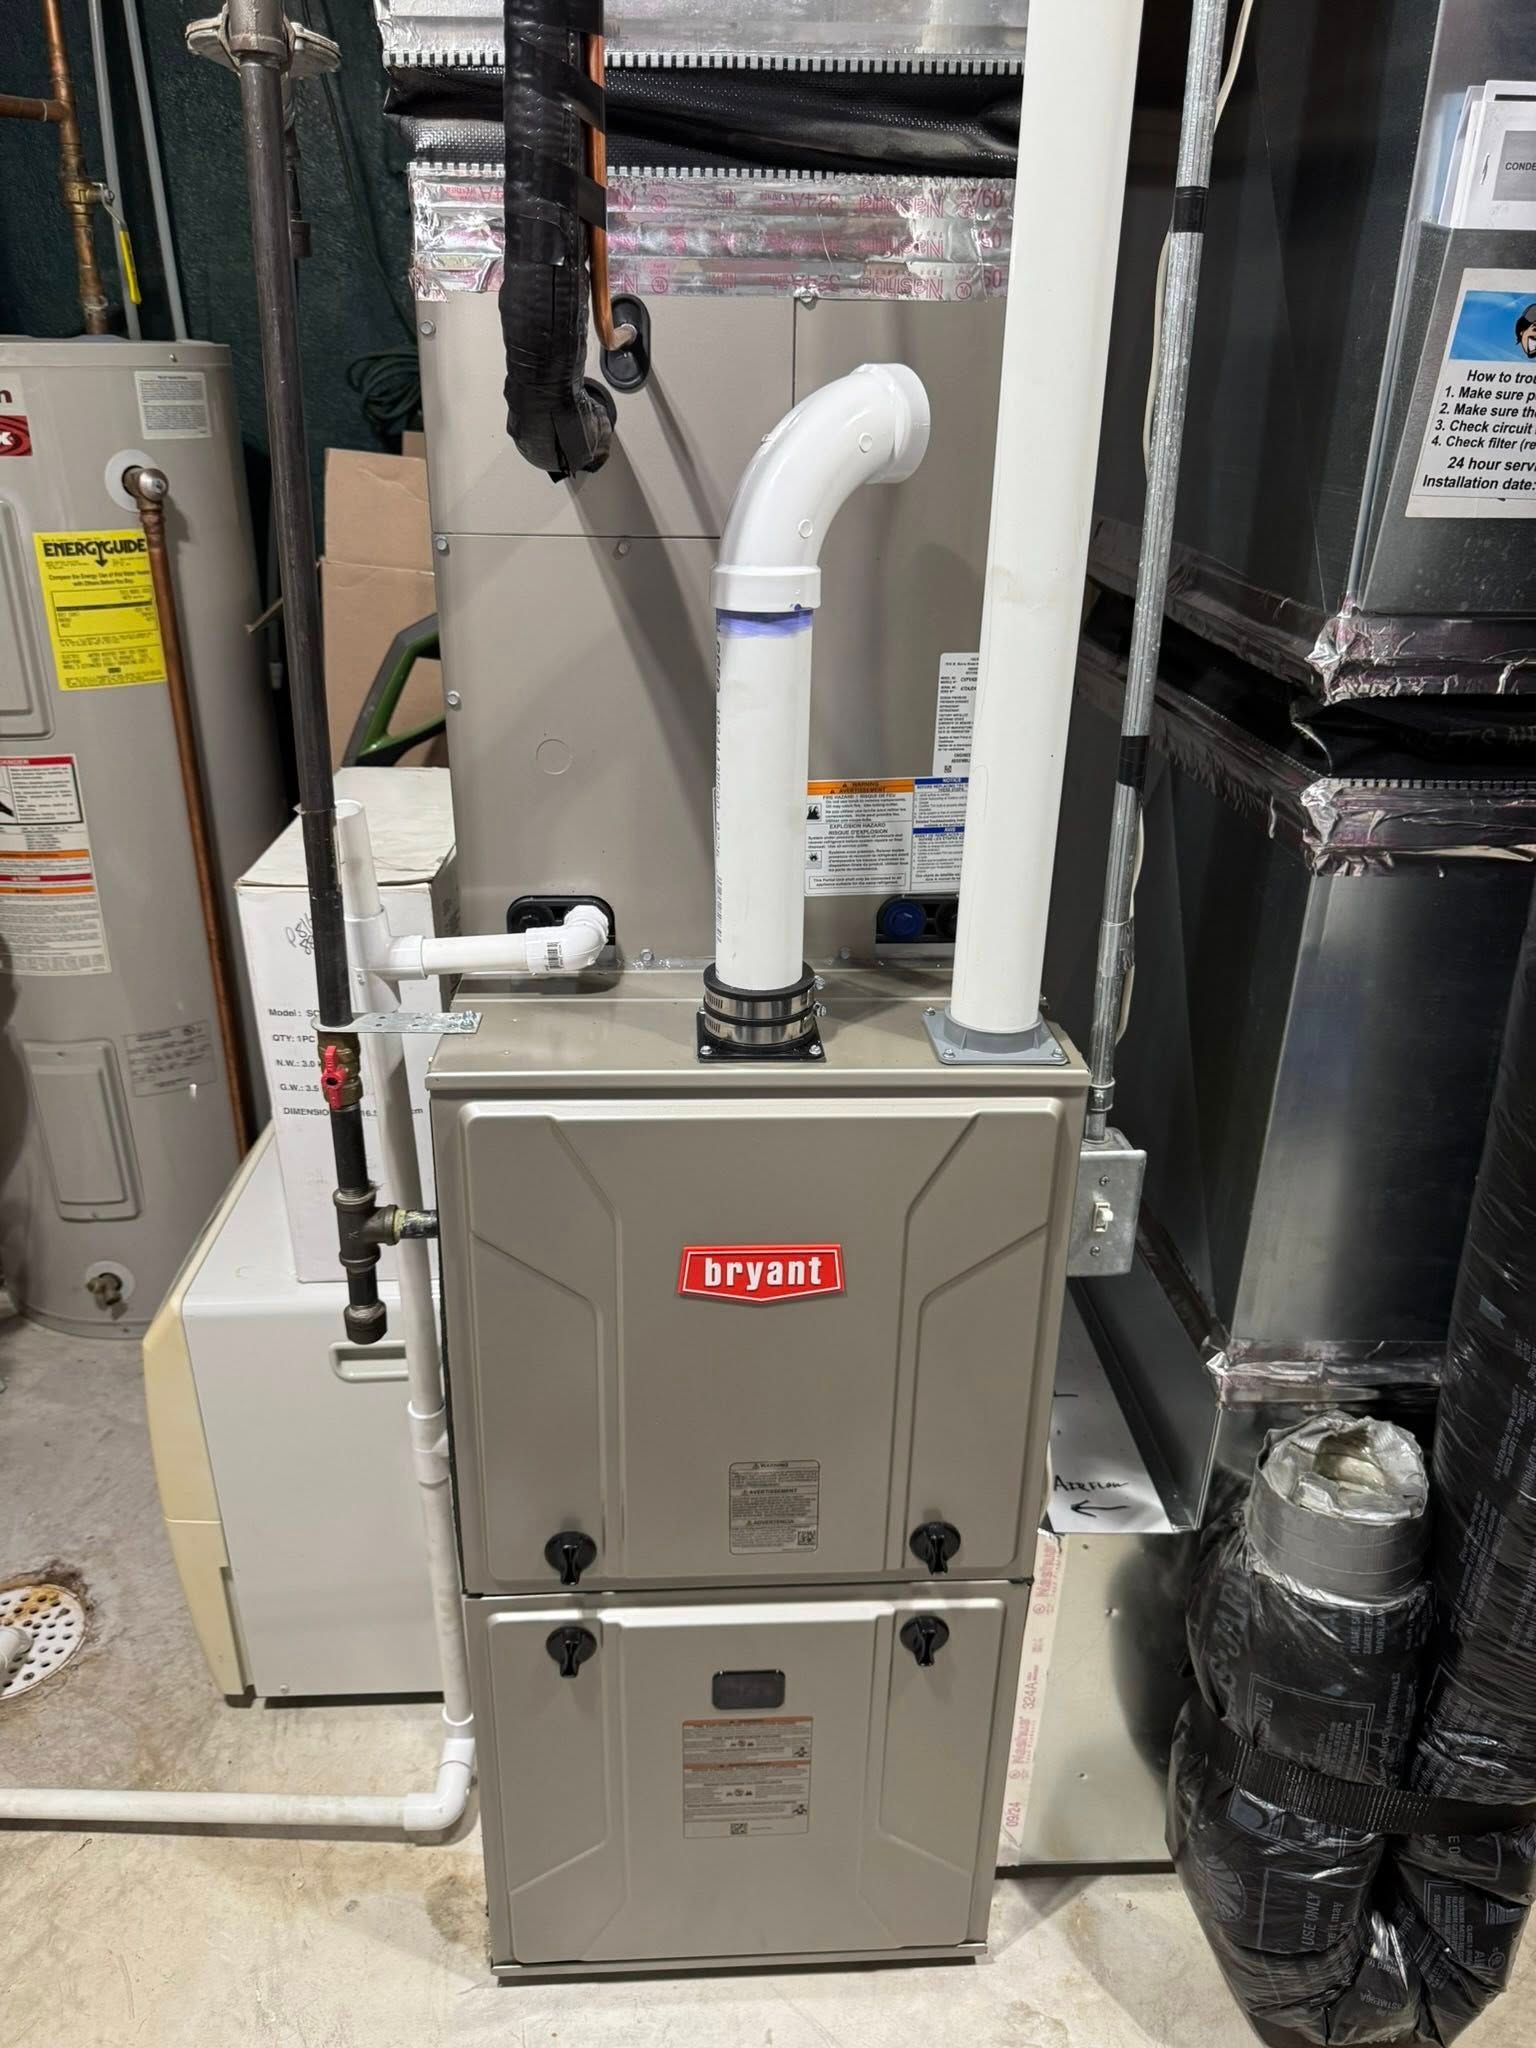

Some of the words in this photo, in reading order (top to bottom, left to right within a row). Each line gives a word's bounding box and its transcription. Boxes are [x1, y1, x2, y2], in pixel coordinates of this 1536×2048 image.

[858, 278, 944, 299] Nashua
[1467, 369, 1496, 382] How
[1498, 371, 1512, 384] to
[1445, 386, 1454, 398] 1.
[1459, 386, 1492, 399] Make
[1495, 389, 1524, 401] sure
[1439, 402, 1450, 415] 2.
[1454, 403, 1487, 416] Make
[1490, 407, 1519, 417] sure
[1435, 419, 1445, 431] 3.
[1449, 419, 1489, 433] Check
[1492, 422, 1533, 434] circuit
[1431, 435, 1441, 446] 4.
[1446, 435, 1485, 448] Check
[1488, 437, 1518, 450] filter
[1447, 456, 1465, 469] 24
[1468, 457, 1501, 471] hour
[1422, 474, 1498, 490] Installation
[272, 1034, 295, 1042] QTY:
[297, 1035, 316, 1043] 1PC
[704, 1256, 822, 1291] bryant
[1022, 1681, 1039, 1709] 324A
[1010, 1716, 1031, 1764] Nashua
[1005, 1801, 1021, 1827] 09/24
[1304, 1891, 1321, 1921] ONLY
[1301, 1923, 1316, 1946] USE
